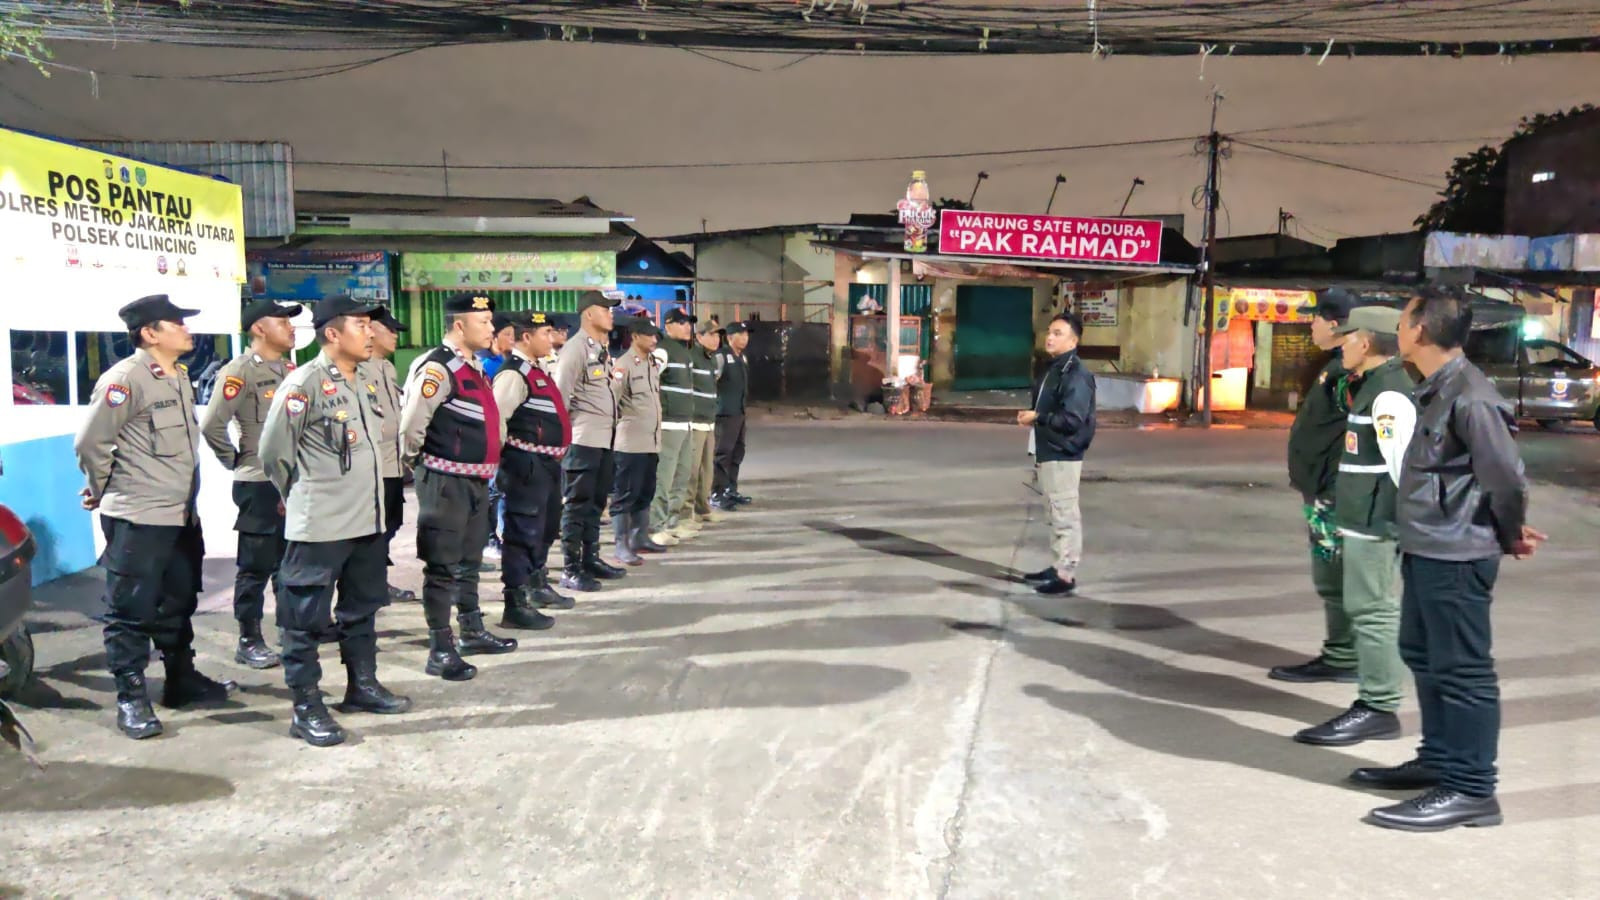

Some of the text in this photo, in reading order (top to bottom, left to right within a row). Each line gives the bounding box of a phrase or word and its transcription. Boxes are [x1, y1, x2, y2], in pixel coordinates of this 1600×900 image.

[48, 170, 192, 219] POS PANTAU
[52, 222, 197, 255] POLSEK CILINCING
[64, 201, 123, 226] METRO
[129, 213, 193, 237] JAKARTA
[197, 224, 235, 243] UTARA
[957, 215, 1146, 237] WARUNG SATE MADURA
